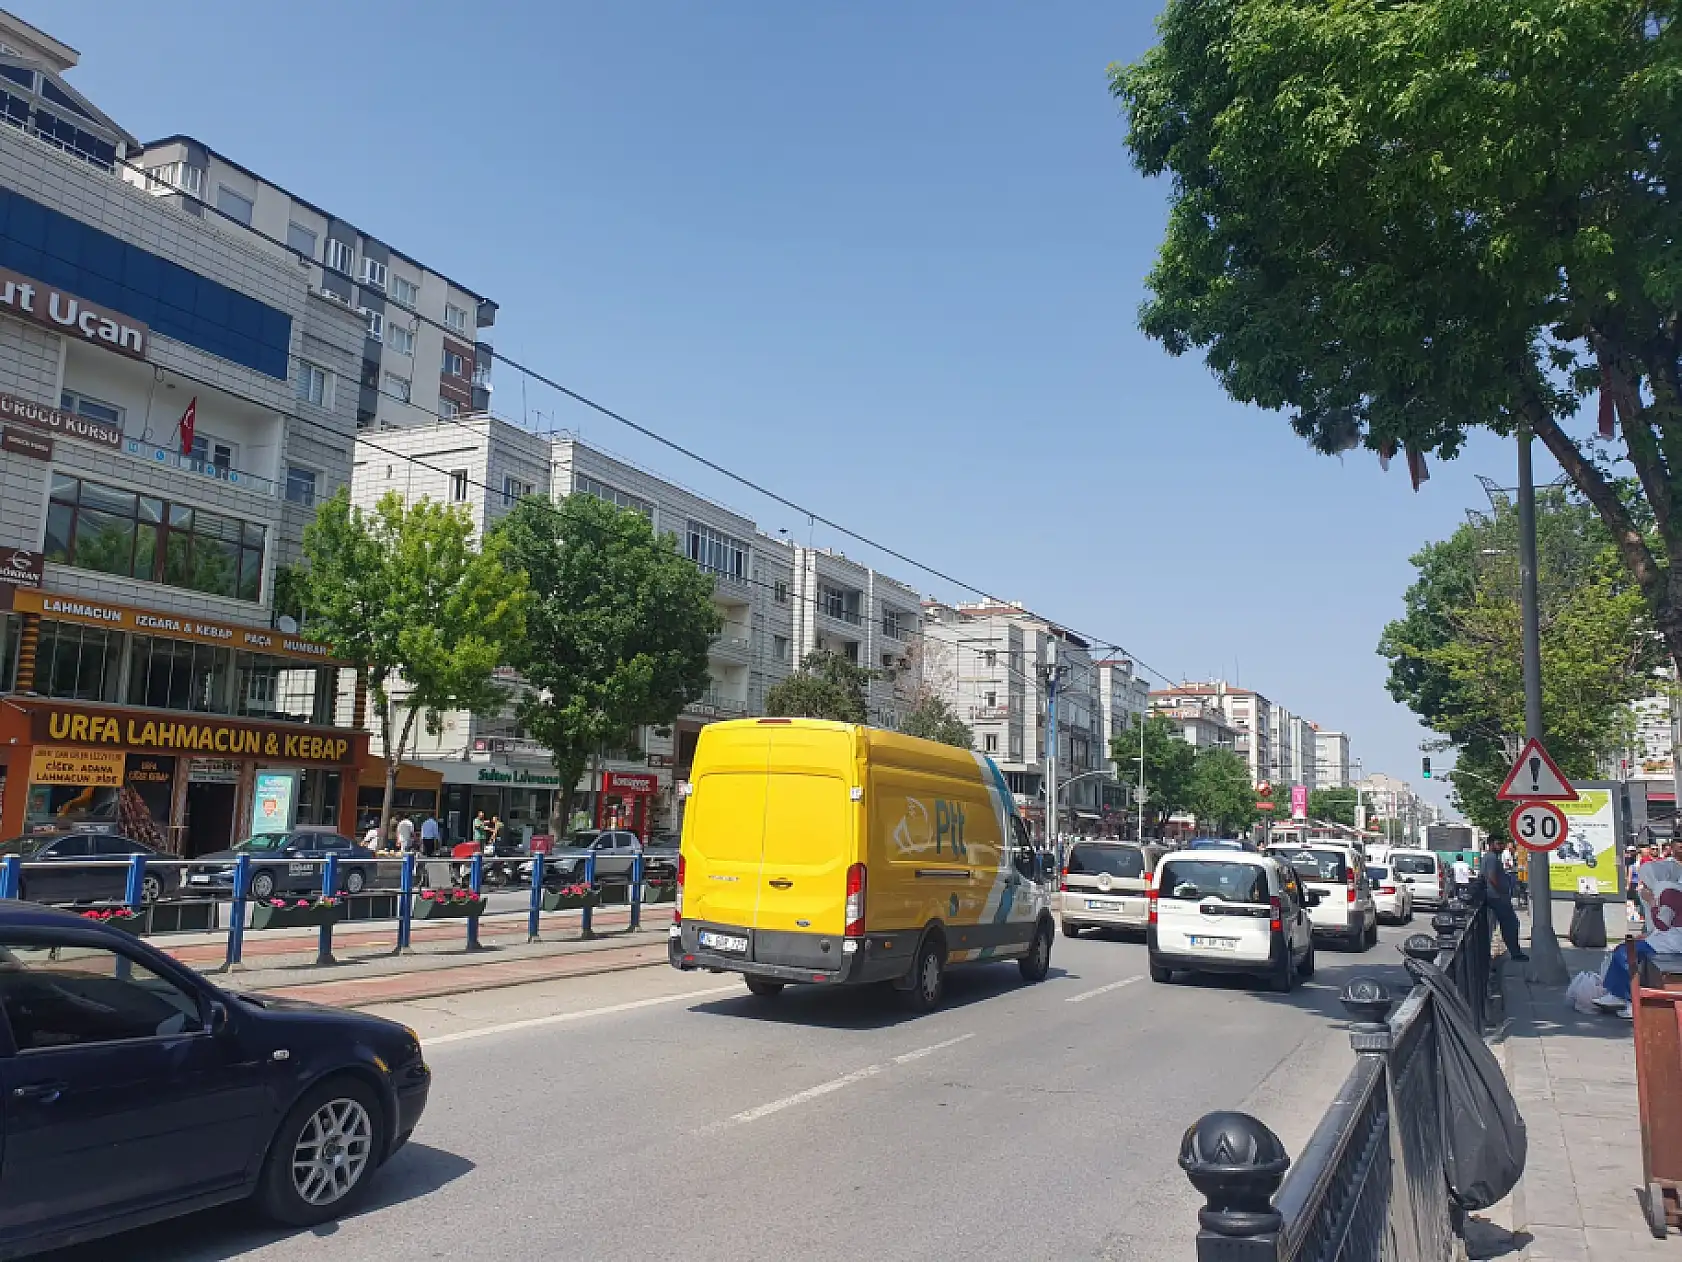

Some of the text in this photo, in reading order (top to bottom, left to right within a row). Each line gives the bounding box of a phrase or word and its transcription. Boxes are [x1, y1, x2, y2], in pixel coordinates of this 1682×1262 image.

[49, 291, 142, 352] Uçan
[66, 417, 118, 444] KURSU
[43, 600, 122, 622] LAHMACUN
[196, 624, 232, 638] KEBAP
[50, 712, 348, 760] URFA LAHMACUN & KEBAP
[36, 772, 89, 782] LAHMACUN
[934, 799, 967, 857] Ptt
[1521, 814, 1556, 839] 30
